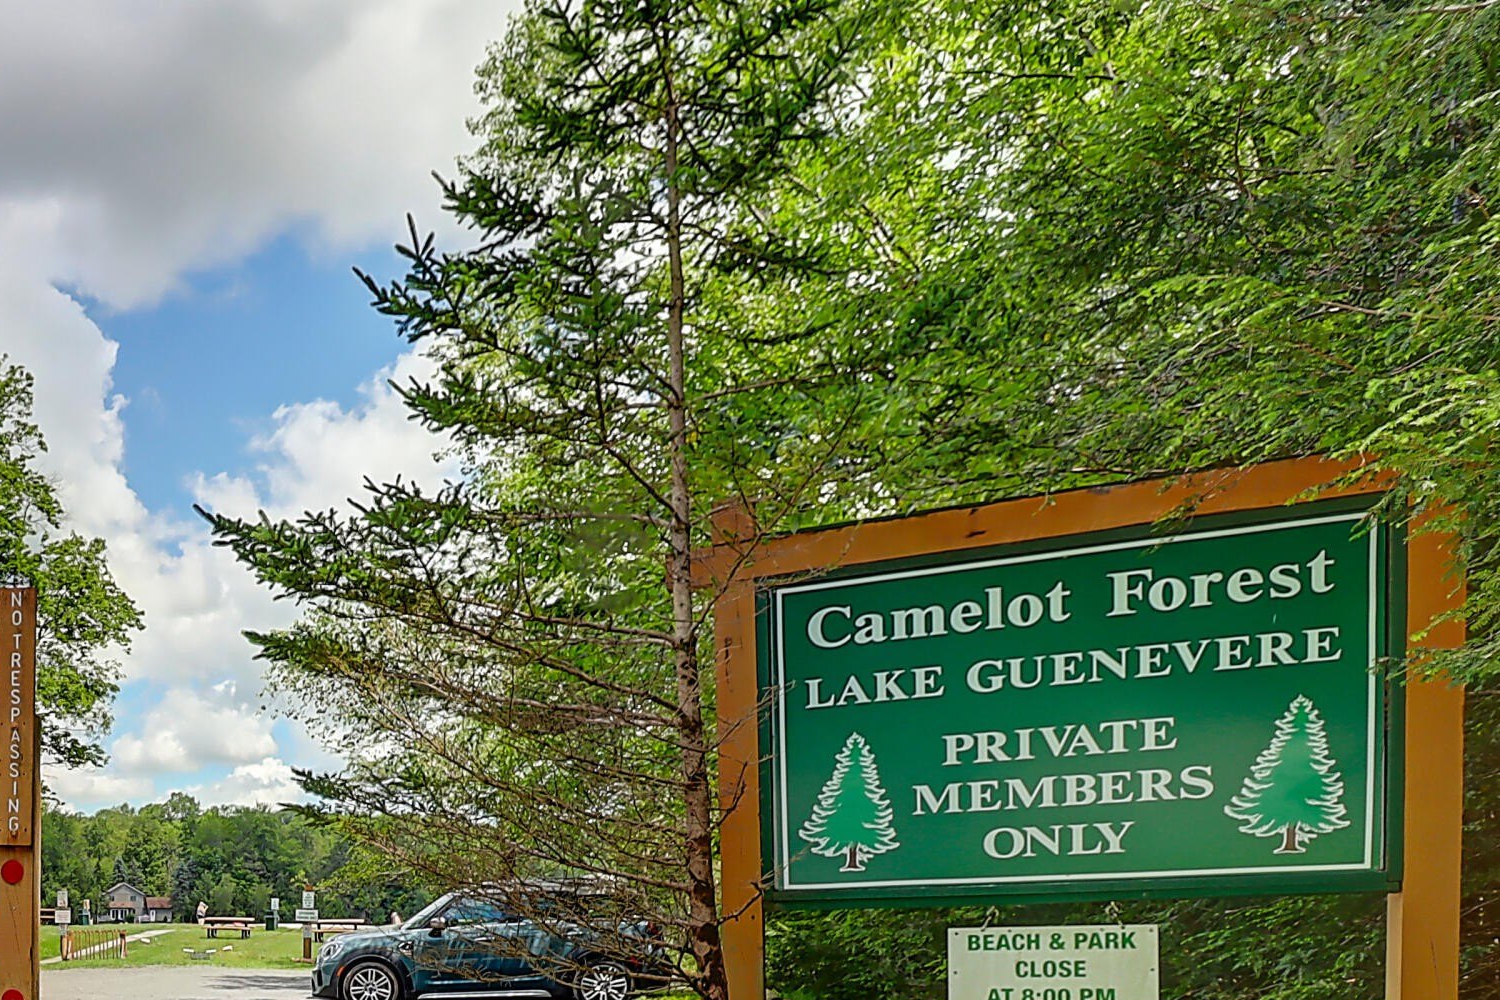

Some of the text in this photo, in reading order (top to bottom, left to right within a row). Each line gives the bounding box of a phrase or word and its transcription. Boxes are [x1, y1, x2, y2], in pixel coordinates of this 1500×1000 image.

[806, 549, 1337, 649] Camelot Forest
[805, 626, 1343, 709] LAKE GUENEVERE
[8, 591, 22, 831] NO TRESPASSING
[941, 717, 1178, 767] PRIVATE
[912, 765, 1214, 815] MEMBERS
[983, 821, 1135, 860] ONLY
[967, 932, 1137, 951] BEACH & PARK
[1015, 960, 1087, 978] CLOSE
